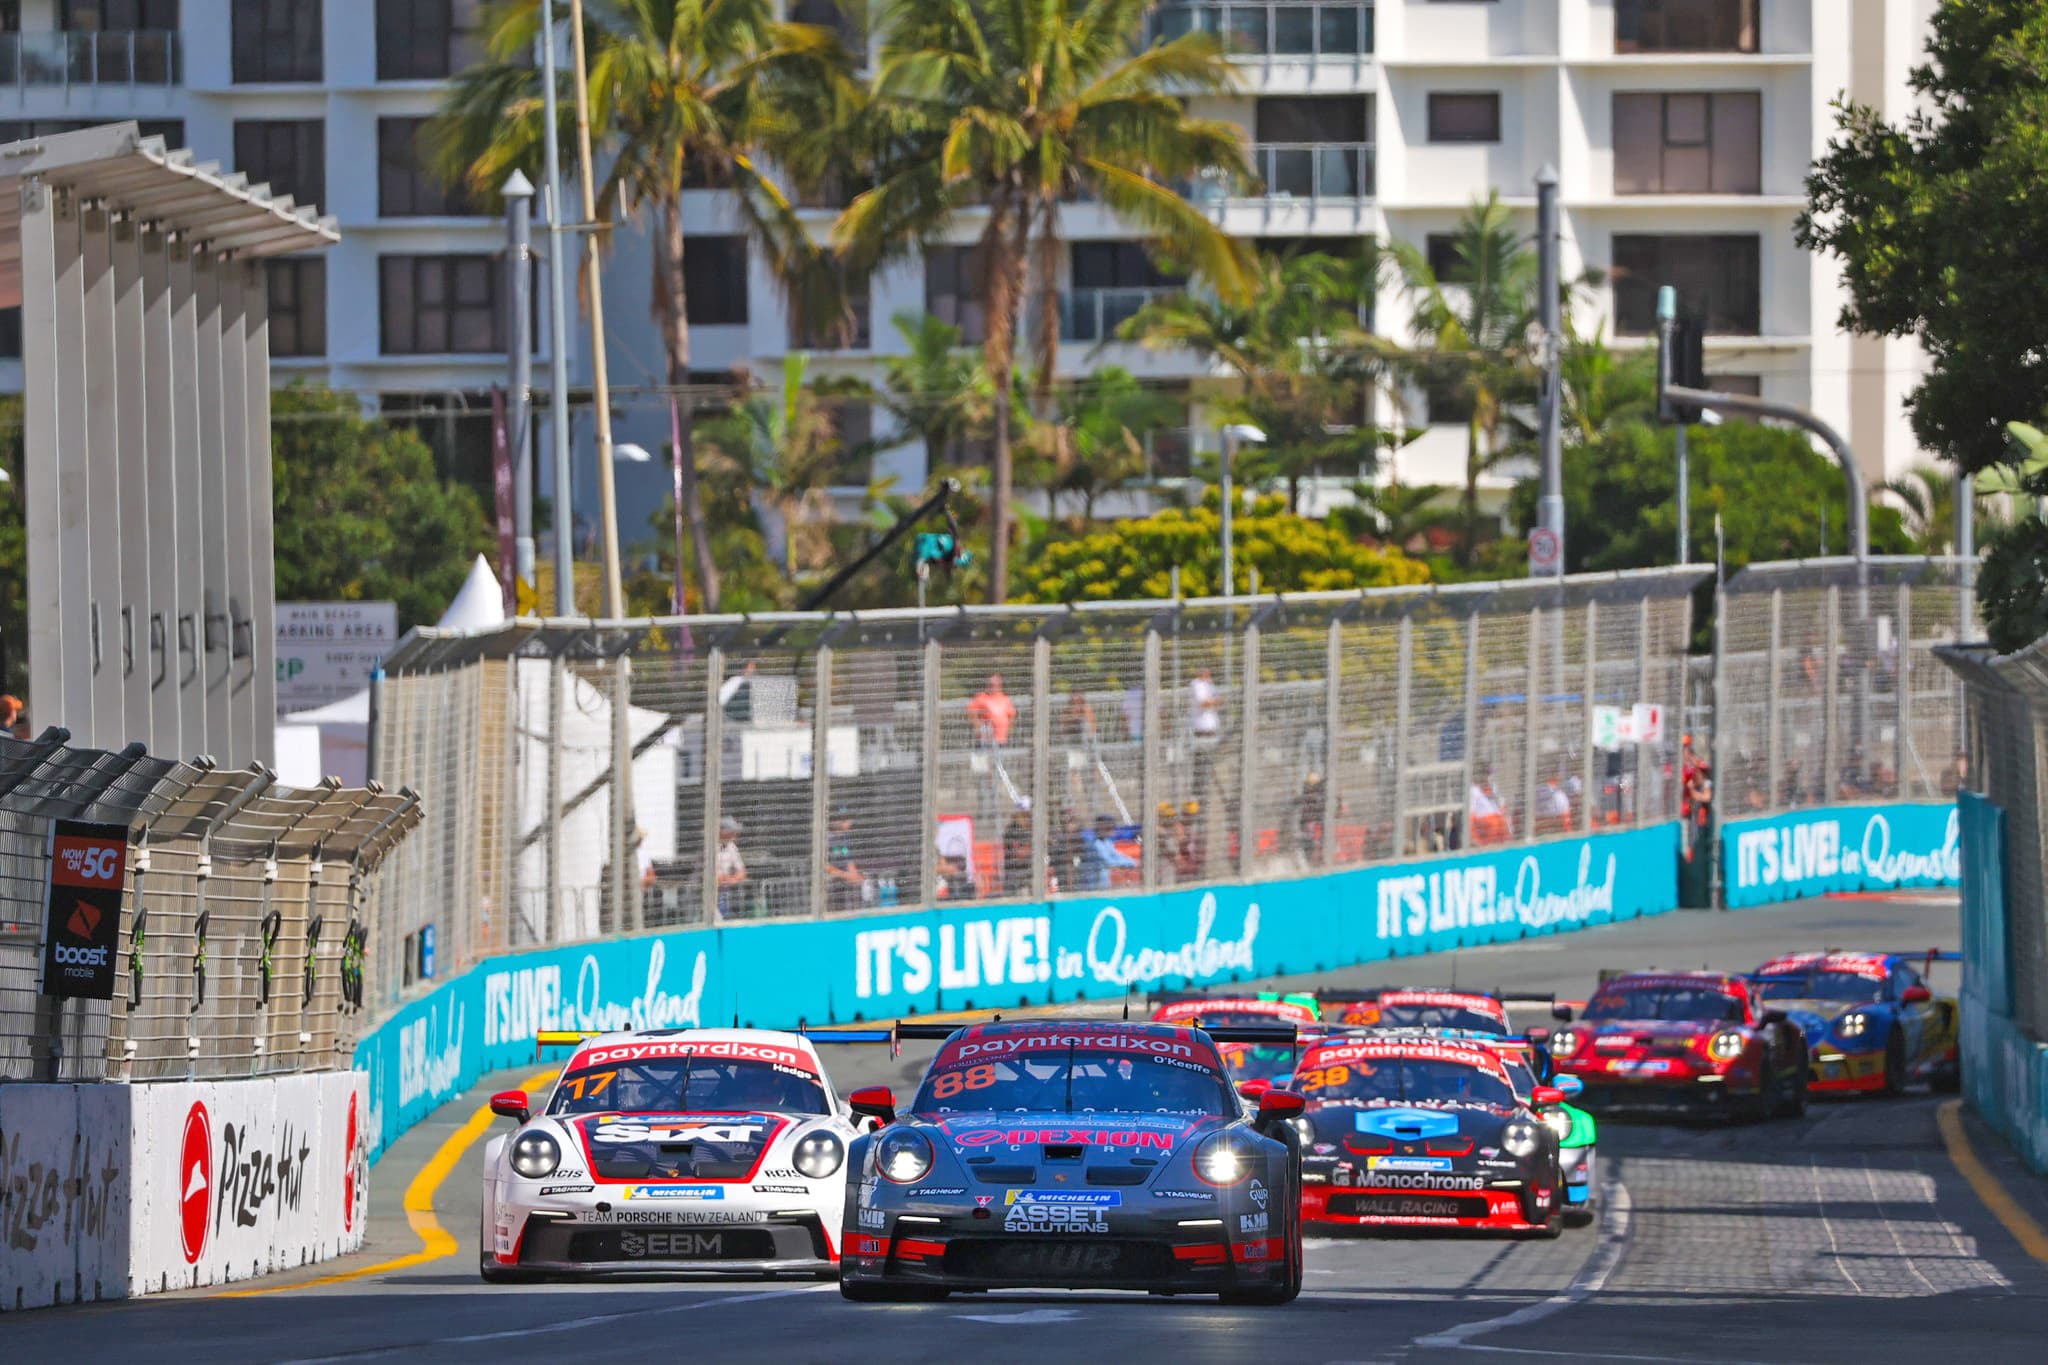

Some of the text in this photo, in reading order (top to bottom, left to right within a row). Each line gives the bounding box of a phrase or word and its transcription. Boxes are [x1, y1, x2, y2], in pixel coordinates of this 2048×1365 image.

[277, 623, 335, 638] ARKING
[62, 848, 84, 861] NOW
[81, 847, 118, 880] 5G
[1738, 827, 1779, 888] IT'S
[1781, 820, 1839, 882] LIVE!
[1841, 846, 1861, 875] in
[67, 860, 82, 871] ON
[1377, 842, 1616, 939] IT'S LIVE! in Queensland
[55, 942, 108, 966] boost
[856, 892, 1260, 998] IT'S LIVE! in Queensland
[64, 967, 95, 978] mobile
[577, 938, 707, 1031] Queensland
[588, 1042, 797, 1066] paynterdixon
[958, 1033, 1193, 1059] paynterdixon
[1319, 1044, 1486, 1065] paynterdixon
[772, 1063, 813, 1080] Hedge
[1153, 1055, 1211, 1075] O'Keeffe
[567, 1071, 618, 1100] 17
[933, 1064, 997, 1099] 88
[1301, 1066, 1350, 1092] 38
[593, 1123, 763, 1143] SIXT
[1007, 1129, 1174, 1149] DEXION
[63, 1130, 119, 1246] Hut
[216, 1122, 275, 1240] Pizza
[277, 1119, 310, 1221] Hut
[1356, 1168, 1484, 1190] Monochrome
[651, 1189, 716, 1197] MICHELIN
[1037, 1193, 1112, 1203] MICHELIN
[582, 1210, 764, 1223] TEAM PORSCHE NEW ZEALAND
[1004, 1206, 1110, 1222] ASSET
[1355, 1200, 1459, 1214] WALL RACING
[1003, 1221, 1109, 1233] SOLUTIONS
[647, 1232, 723, 1255] EBM
